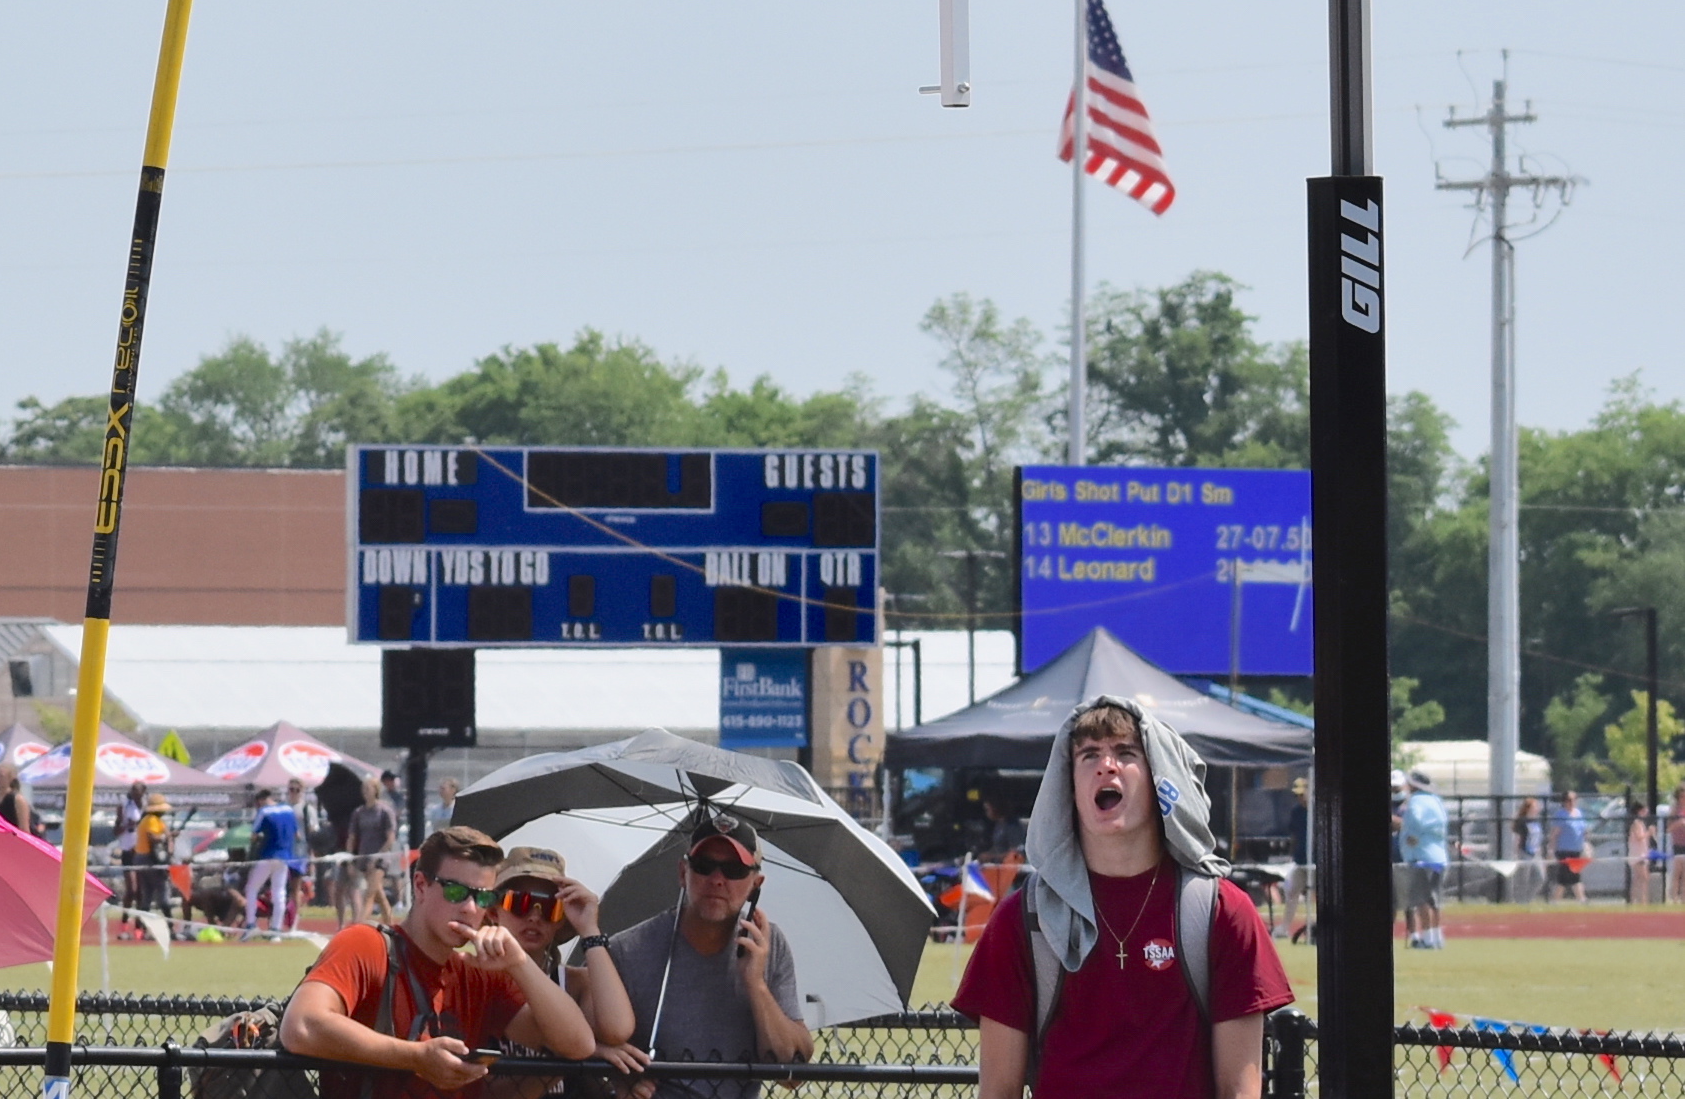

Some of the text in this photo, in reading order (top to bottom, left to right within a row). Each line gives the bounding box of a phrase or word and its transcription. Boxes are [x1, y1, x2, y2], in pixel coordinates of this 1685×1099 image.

[1340, 198, 1380, 334] GILL
[384, 450, 460, 486] HOME
[764, 454, 867, 489] GUESTS
[1021, 480, 1234, 505] Girls Shot Put D1 Sm
[1024, 522, 1052, 547] 13
[1059, 523, 1172, 548] McClerkin
[363, 550, 427, 585] DOWN
[441, 550, 550, 585] YDS TO GO
[705, 552, 787, 587] BALL ON
[819, 553, 863, 587] QTR
[1024, 555, 1156, 581] 14 Leonard
[722, 676, 803, 698] FirstBank
[1143, 946, 1175, 960] TSSAA
